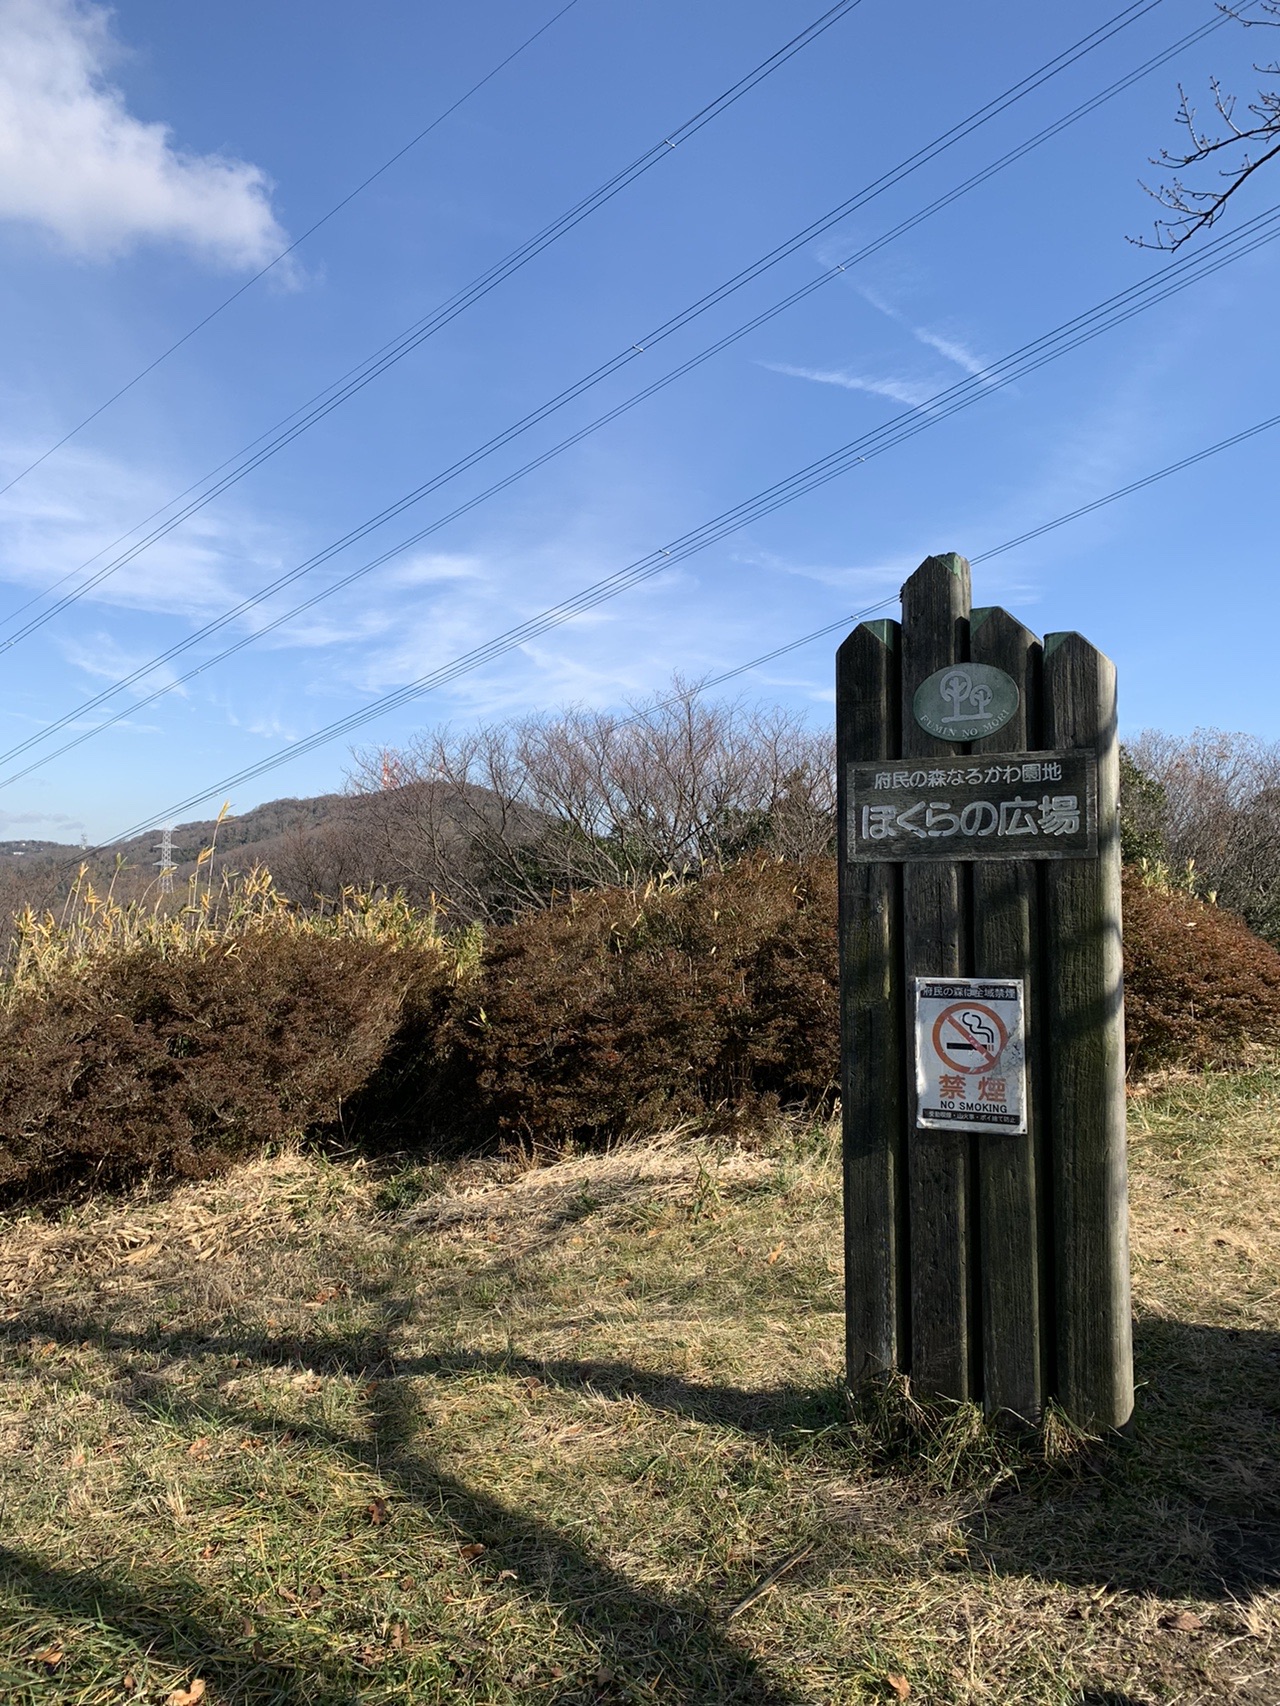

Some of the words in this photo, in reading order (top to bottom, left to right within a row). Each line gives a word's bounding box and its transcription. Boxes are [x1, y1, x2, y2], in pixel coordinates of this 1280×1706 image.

[920, 714, 957, 737] FUMIN
[962, 727, 978, 738] NO
[982, 709, 1010, 732] MORI
[874, 762, 1063, 790] 府民の森なるかわ園地
[861, 795, 1081, 840] ぼくらの広場
[938, 1074, 1007, 1103] 禁煙
[940, 1100, 955, 1110] NO
[959, 1101, 1008, 1113] SMOKING
